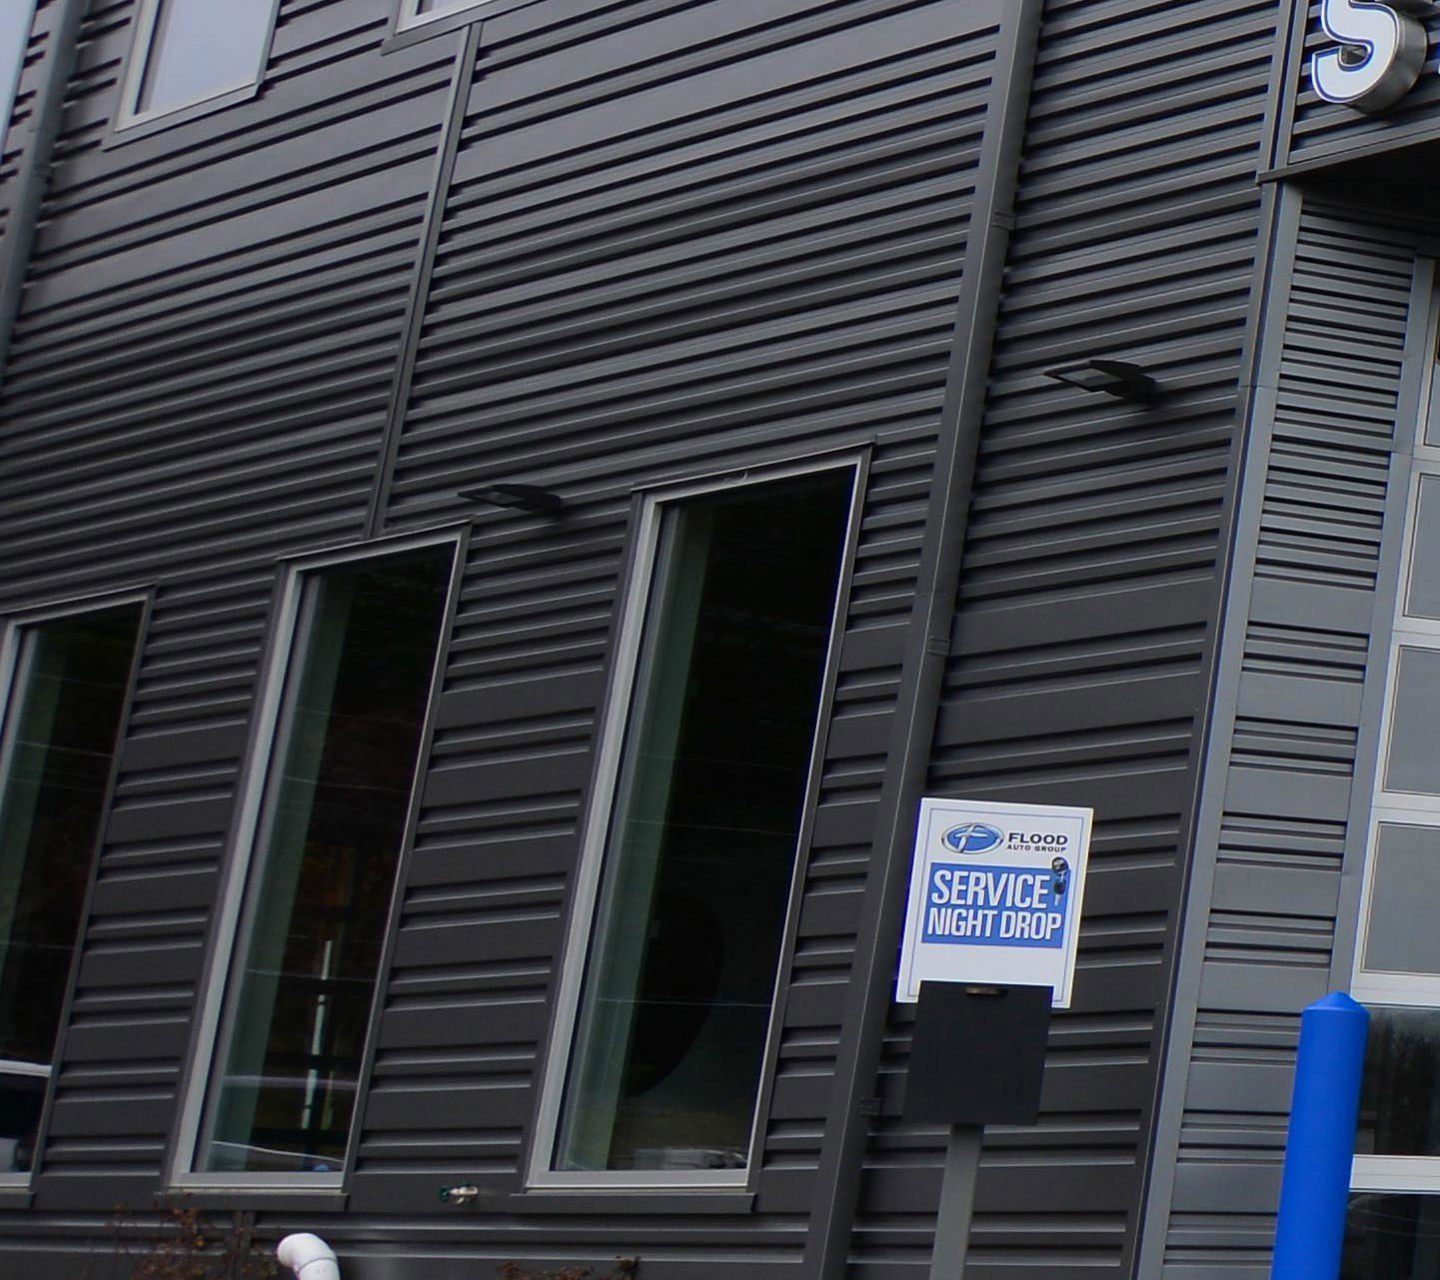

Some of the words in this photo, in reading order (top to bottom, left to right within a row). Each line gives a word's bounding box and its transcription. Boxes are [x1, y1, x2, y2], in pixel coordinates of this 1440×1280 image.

[1008, 832, 1068, 846] FLOOD
[931, 869, 1050, 909] SERVICE
[927, 907, 998, 938] NIGHT
[1000, 910, 1062, 941] DROP
